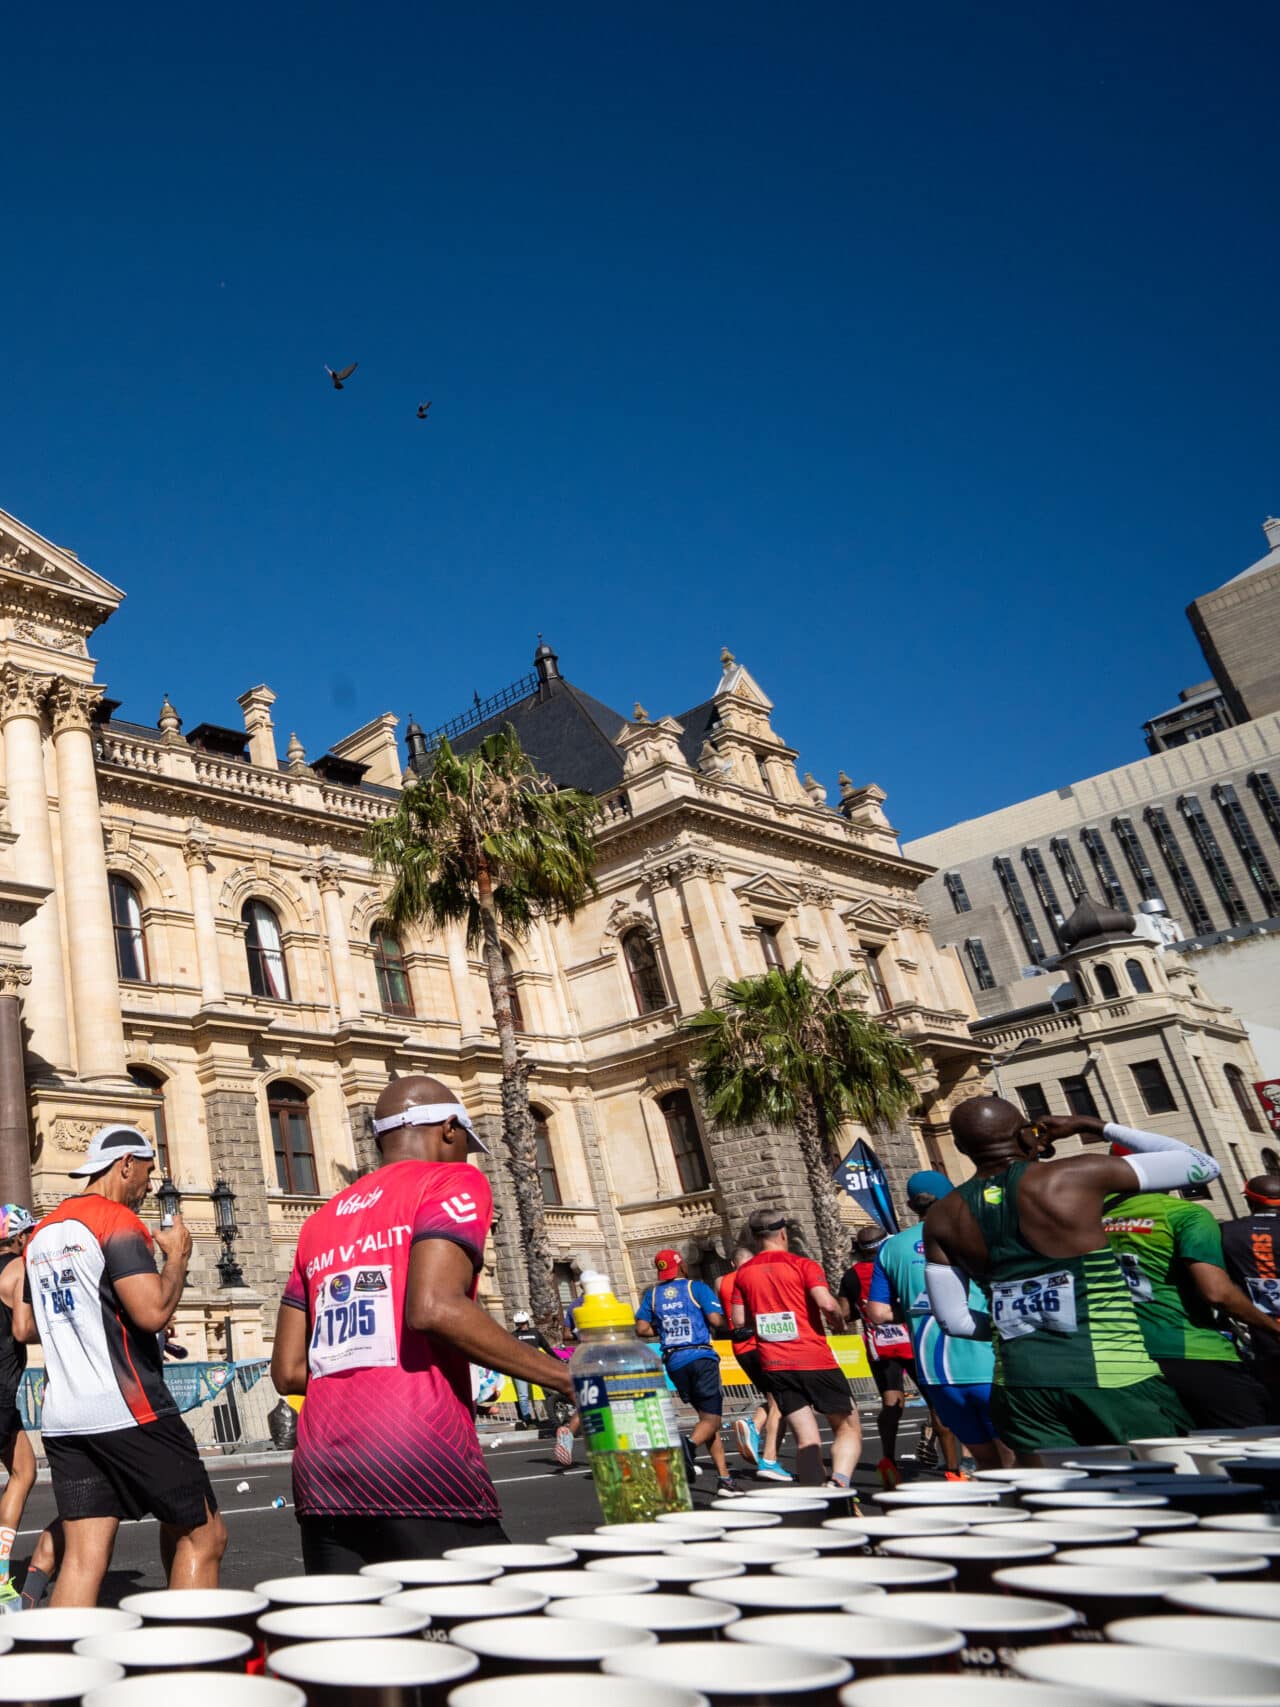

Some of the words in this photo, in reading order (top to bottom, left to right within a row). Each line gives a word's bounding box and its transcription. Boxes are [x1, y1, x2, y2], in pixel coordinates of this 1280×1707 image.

[306, 1248, 334, 1280] EAM
[357, 1273, 384, 1283] ASA
[1012, 1289, 1060, 1315] 436
[759, 1321, 795, 1335] T49340
[960, 1647, 996, 1665] NO
